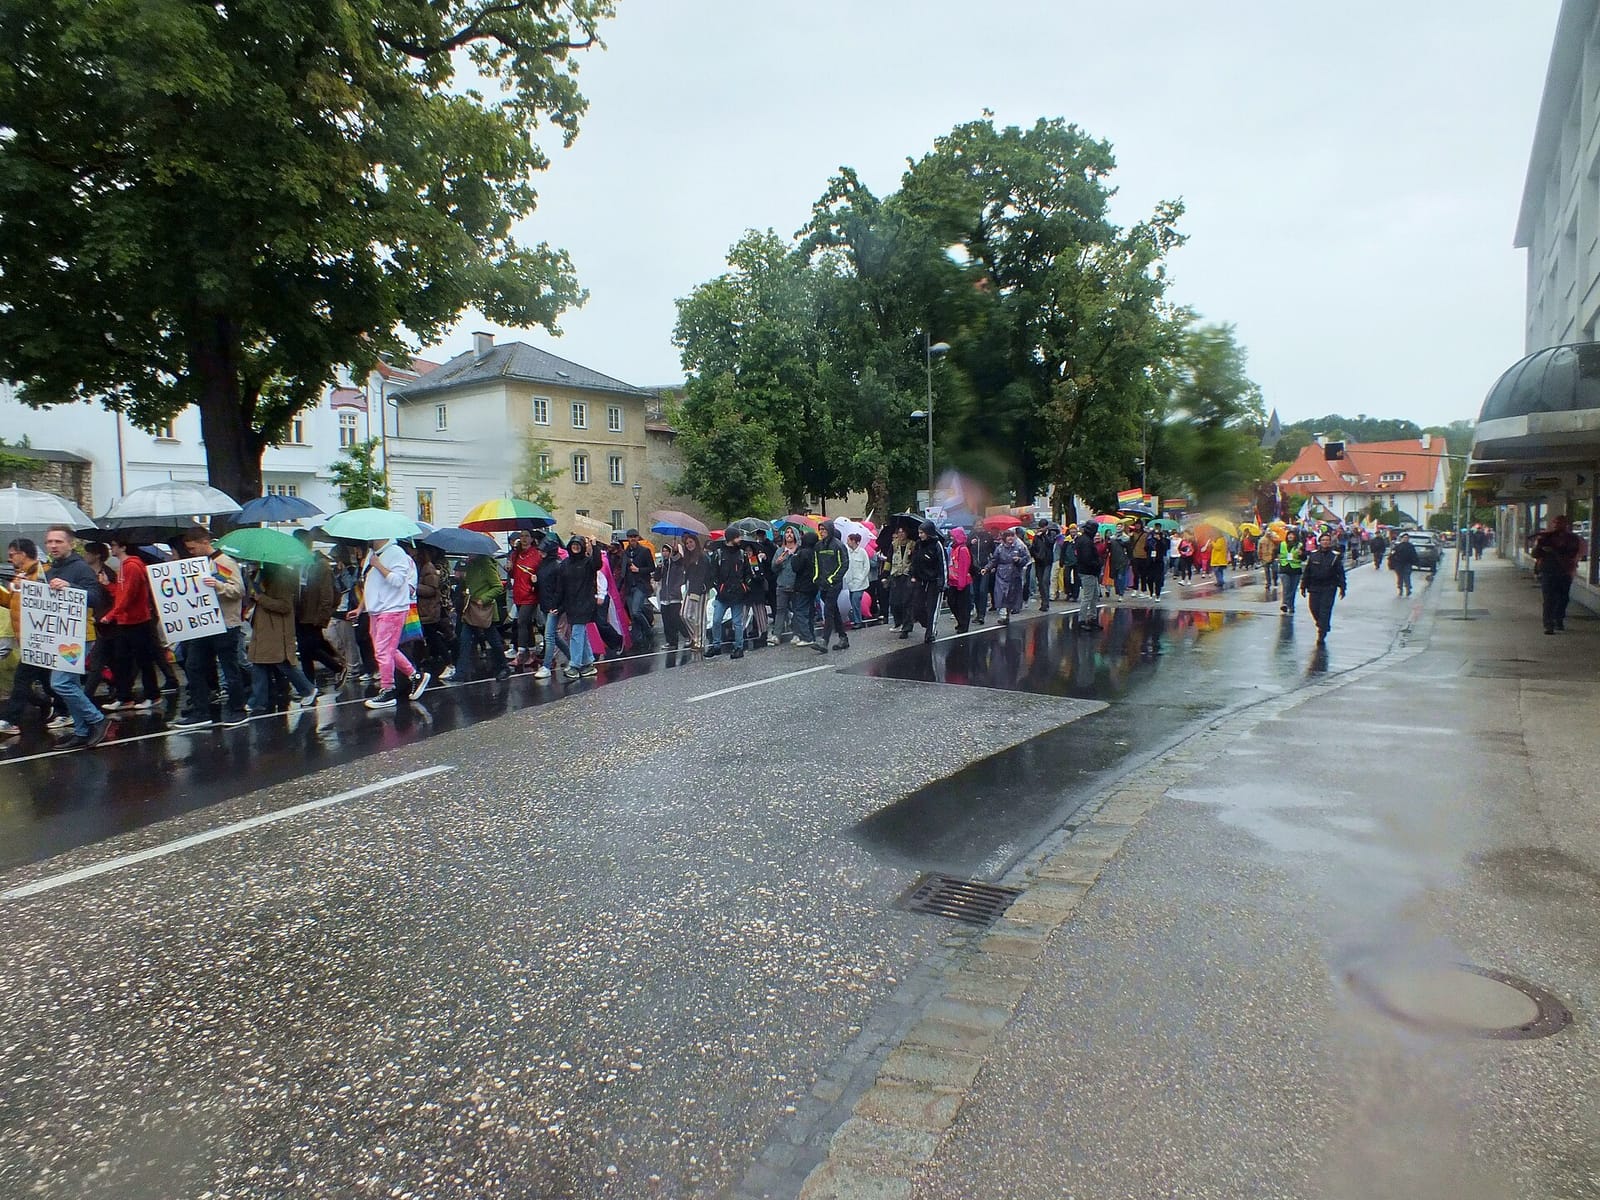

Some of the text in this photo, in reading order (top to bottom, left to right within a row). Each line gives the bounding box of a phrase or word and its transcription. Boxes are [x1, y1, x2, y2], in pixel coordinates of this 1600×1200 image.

[152, 559, 206, 578] DU BIST
[23, 583, 85, 605] MEIN WELSER
[161, 574, 200, 598] GUT
[163, 594, 211, 614] SO WIE
[165, 608, 220, 634] DU BIST!
[30, 633, 55, 644] HEUTE
[23, 648, 58, 668] FREUDE
